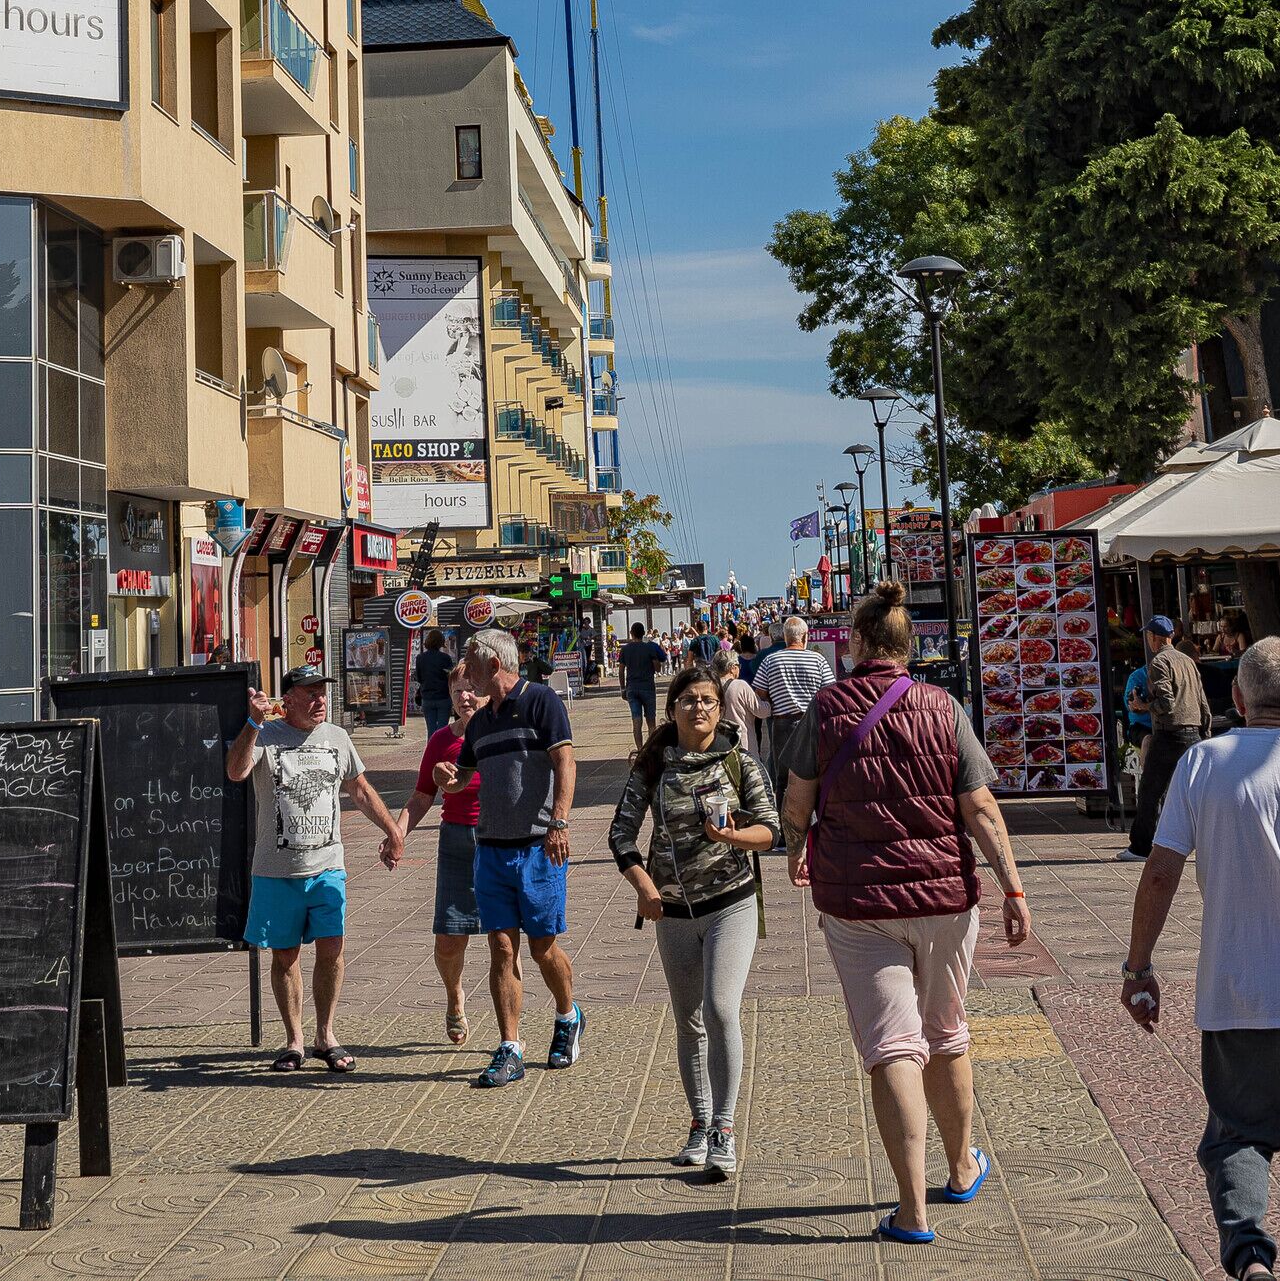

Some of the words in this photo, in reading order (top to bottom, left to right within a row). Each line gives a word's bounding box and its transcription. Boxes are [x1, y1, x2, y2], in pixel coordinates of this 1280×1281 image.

[398, 270, 433, 284] Sunny
[434, 270, 467, 281] Beach
[410, 284, 437, 295] Food
[438, 285, 467, 295] court
[413, 414, 437, 427] BAR
[372, 443, 414, 459] TACO
[417, 442, 460, 457] SHOP
[389, 475, 408, 483] Bella
[410, 475, 429, 483] Rosa
[424, 493, 467, 508] hours
[910, 514, 931, 522] THE
[443, 563, 528, 581] PIZZERIA
[120, 569, 152, 590] CHANGE
[383, 578, 402, 588] Bella
[399, 598, 428, 610] BURGER
[467, 601, 491, 613] BURGER
[400, 605, 428, 618] KING
[468, 607, 492, 620] KING
[911, 622, 950, 636] MEDY
[12, 730, 75, 750] Don't
[24, 750, 67, 765] miss
[142, 778, 182, 805] the
[147, 808, 223, 835] Sunris
[287, 815, 331, 826] WINTER
[287, 824, 331, 836] COMING
